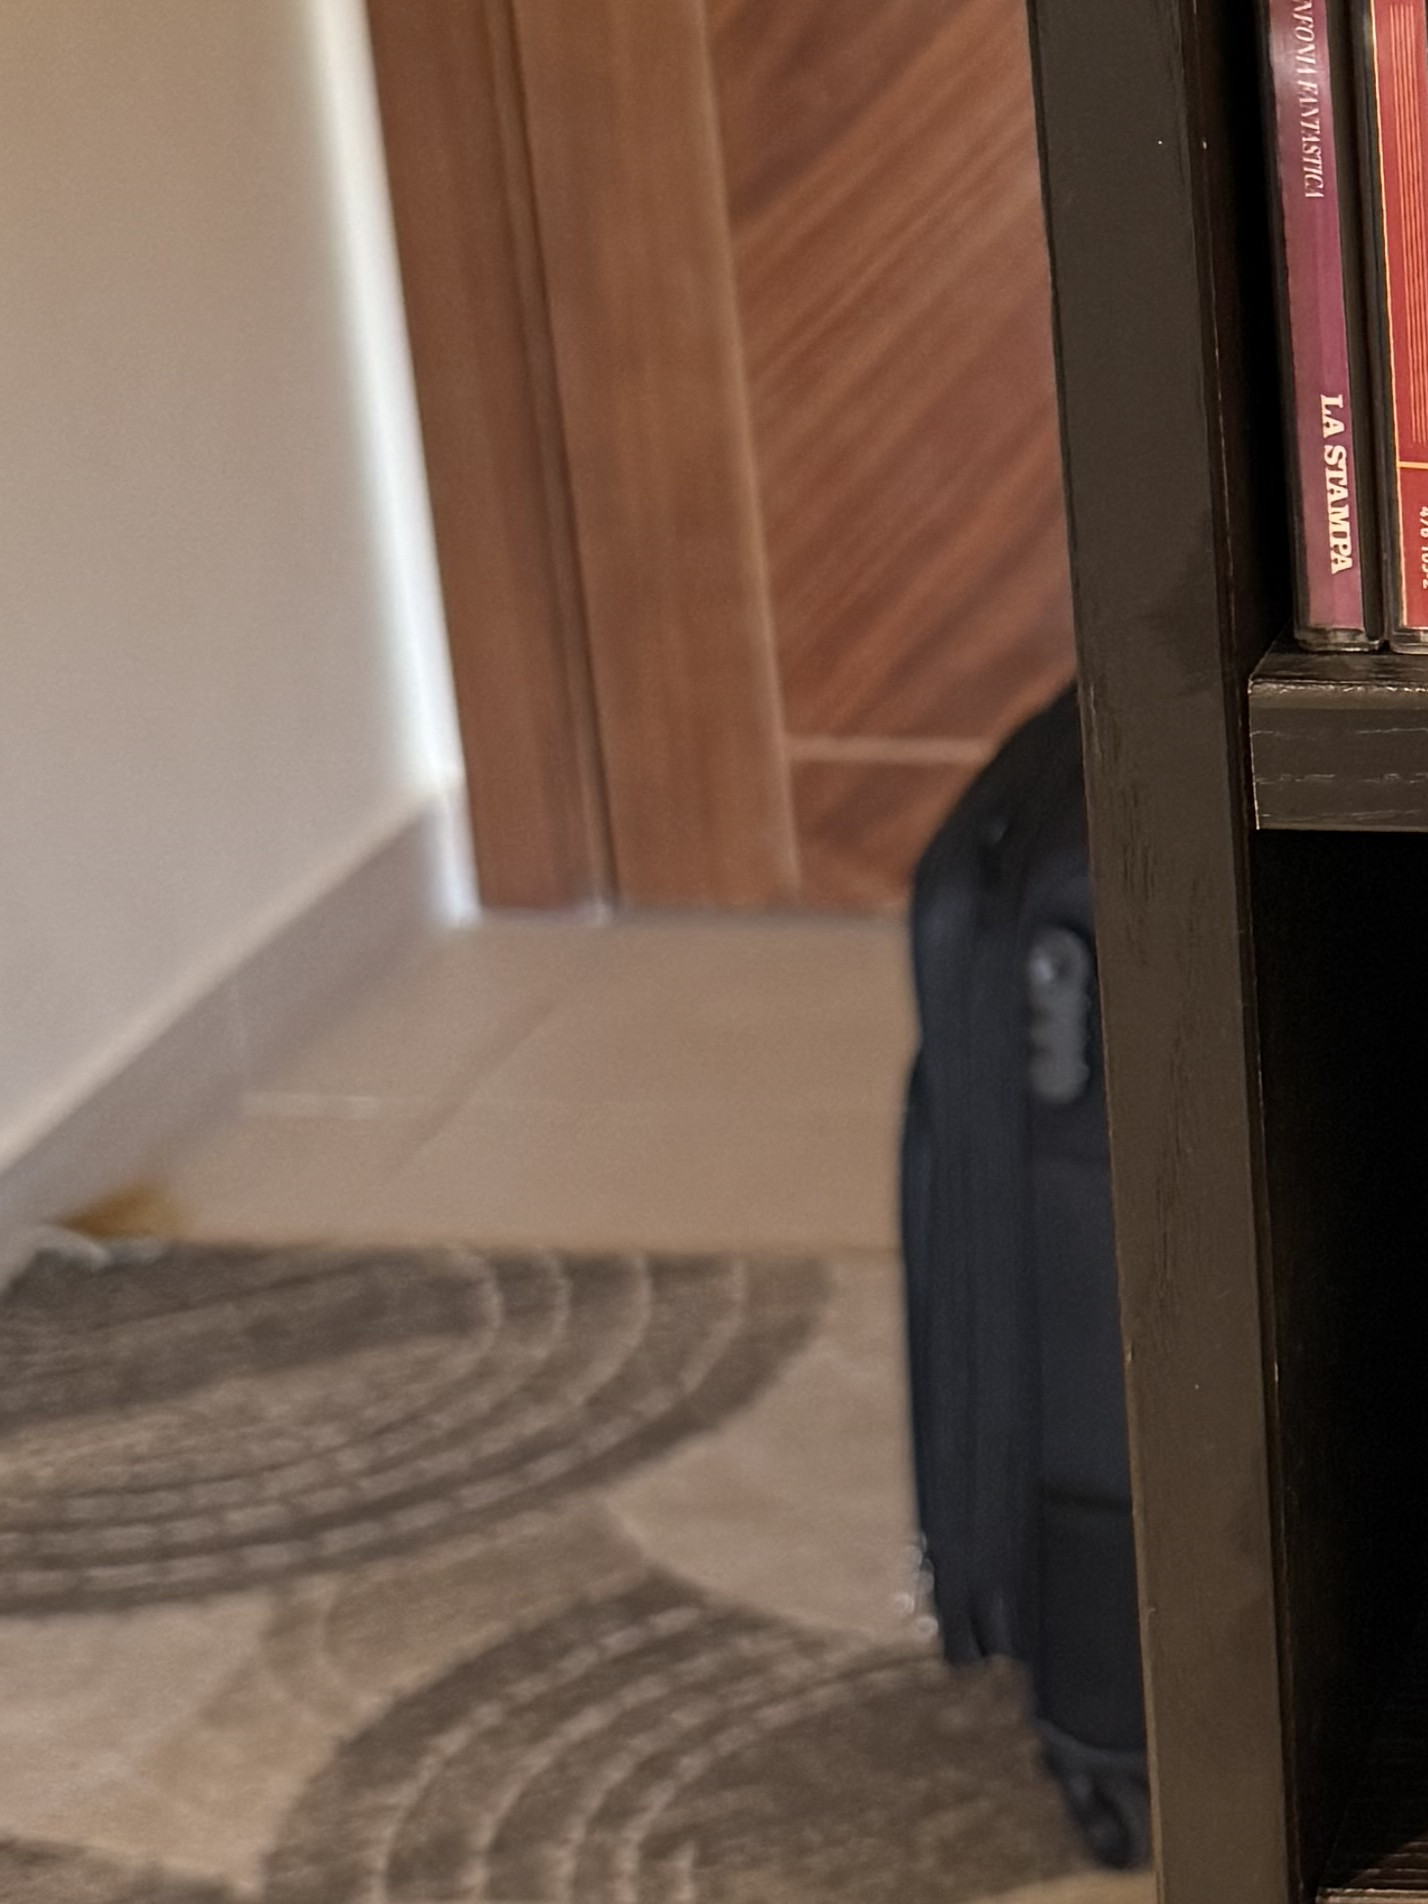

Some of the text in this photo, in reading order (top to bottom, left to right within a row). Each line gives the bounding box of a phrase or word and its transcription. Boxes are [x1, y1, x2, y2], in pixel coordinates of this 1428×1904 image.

[1298, 81, 1325, 198] FANTASTICA
[1320, 394, 1353, 574] LA STAMPA
